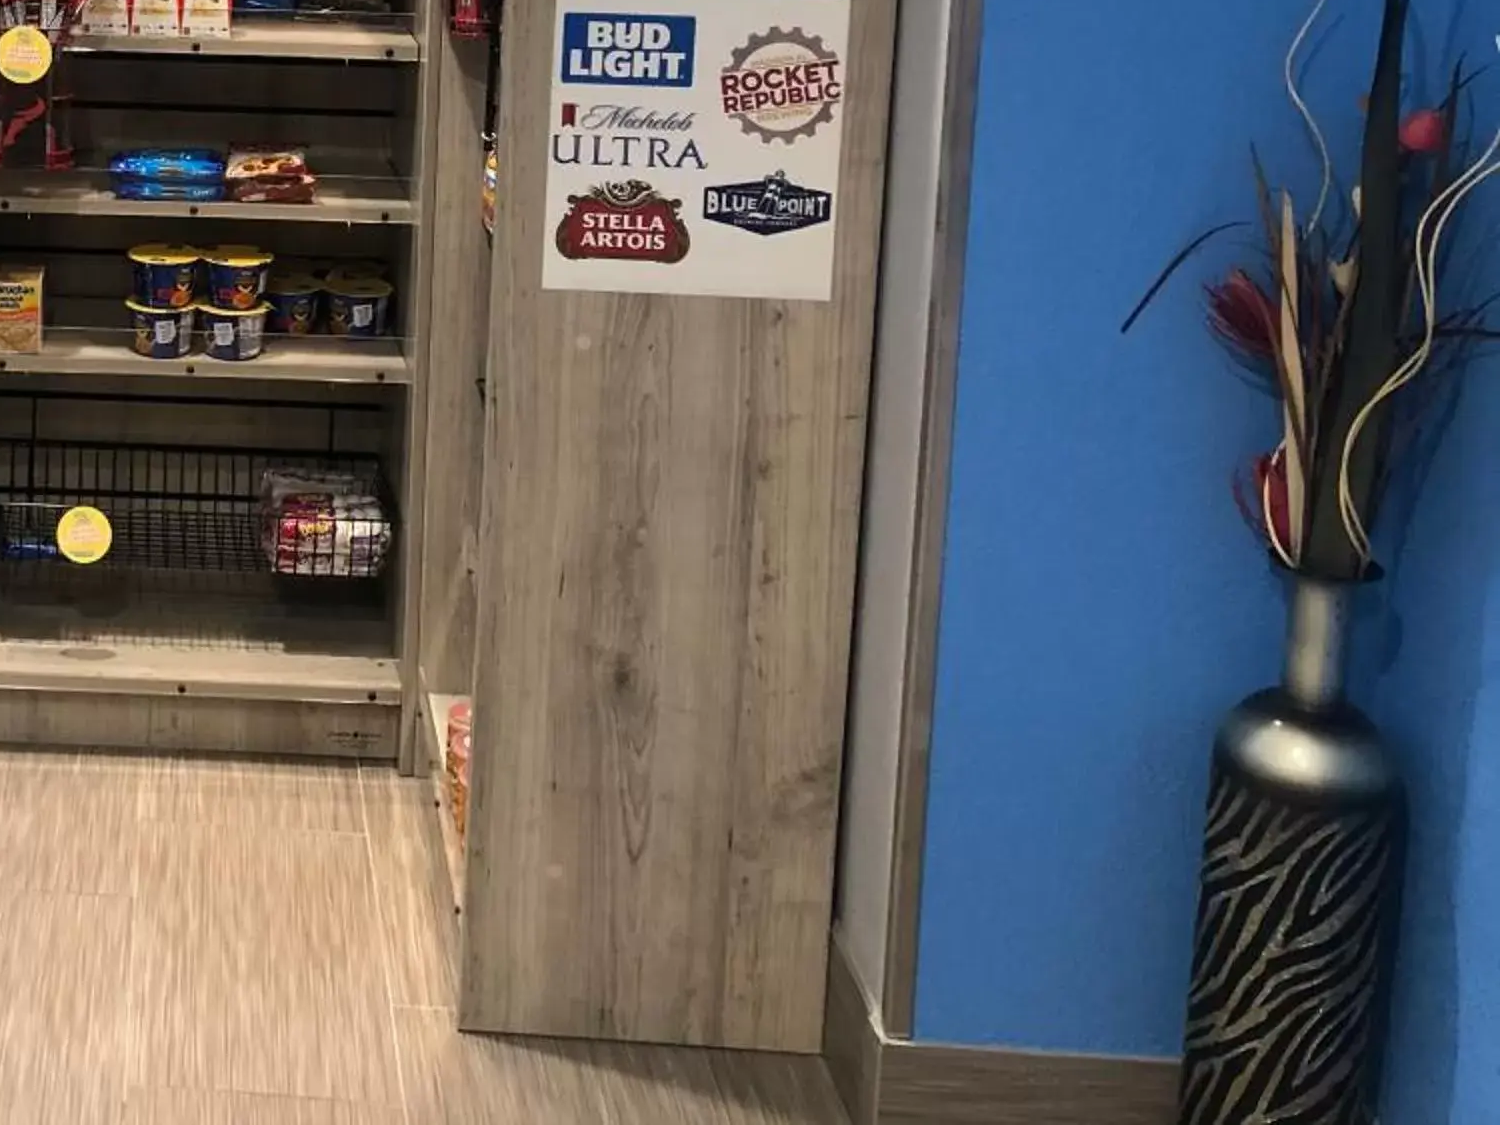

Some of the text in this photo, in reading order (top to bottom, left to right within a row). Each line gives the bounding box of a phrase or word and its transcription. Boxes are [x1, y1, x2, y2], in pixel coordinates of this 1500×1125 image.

[587, 20, 671, 50] BUD
[569, 49, 685, 80] LIGHT
[721, 60, 839, 95] ROCKET
[723, 82, 841, 114] REPUBLIC
[581, 105, 697, 131] Michelob
[552, 134, 708, 169] ULTRA
[707, 191, 826, 217] BLUE POINT
[581, 212, 665, 232] STELLA
[579, 232, 666, 251] ARTOIS
